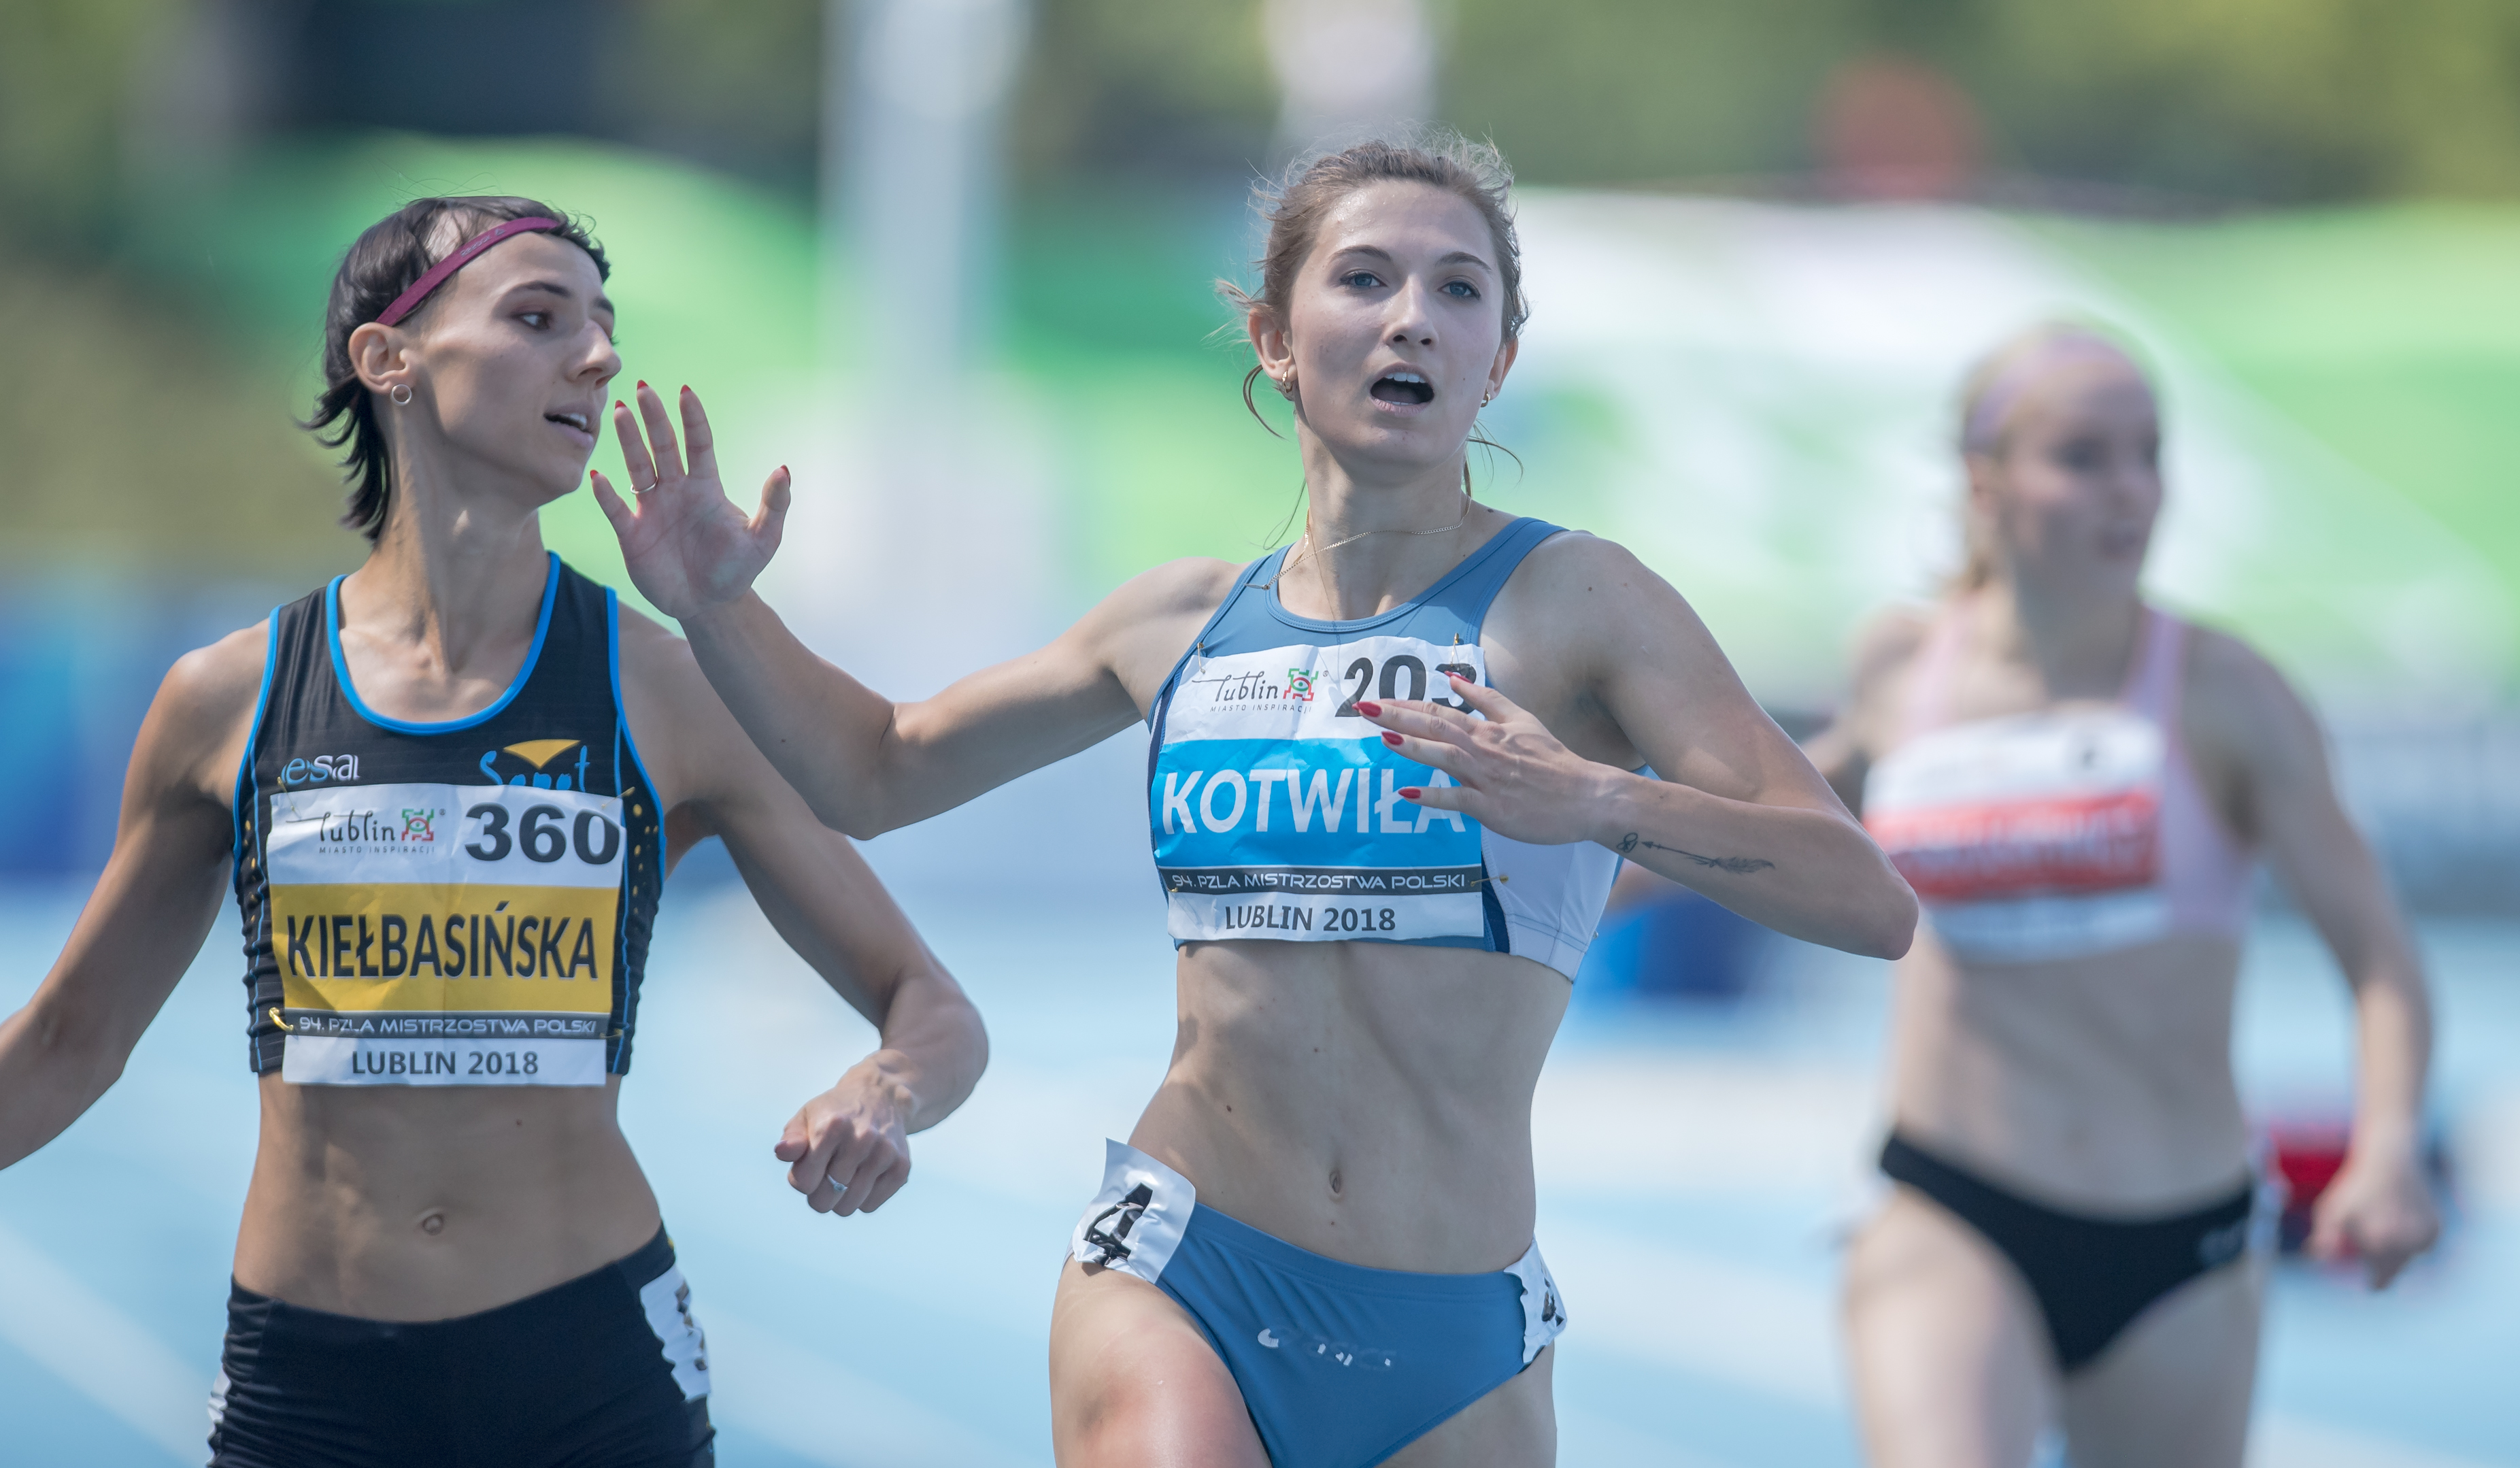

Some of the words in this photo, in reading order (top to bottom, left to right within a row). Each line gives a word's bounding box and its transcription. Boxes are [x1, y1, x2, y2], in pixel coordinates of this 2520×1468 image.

[1334, 654, 1477, 718] 203
[1209, 704, 1246, 712] MIASTO
[1252, 703, 1312, 714] INSPIRACJI
[1162, 767, 1466, 835] KOTWIŁA
[465, 801, 620, 865] 360
[319, 846, 362, 854] MIASTO
[369, 846, 435, 854] INSPIRACJI
[1171, 873, 1197, 887] 94.
[1198, 875, 1241, 889] PZLA
[1243, 873, 1386, 890] MISTRZOSTWA
[1391, 873, 1465, 890] POLSKI
[1225, 905, 1313, 931] LUBLIN
[1323, 907, 1396, 932] 2018
[286, 901, 599, 980] KIEŁBASIŃSKA
[299, 1016, 326, 1032] 94.
[329, 1018, 378, 1033] PZLA
[380, 1018, 530, 1034] MISTRZOSTWA
[533, 1019, 597, 1034] POLSKI
[352, 1050, 456, 1075] LUBLIN
[467, 1050, 539, 1075] 2018
